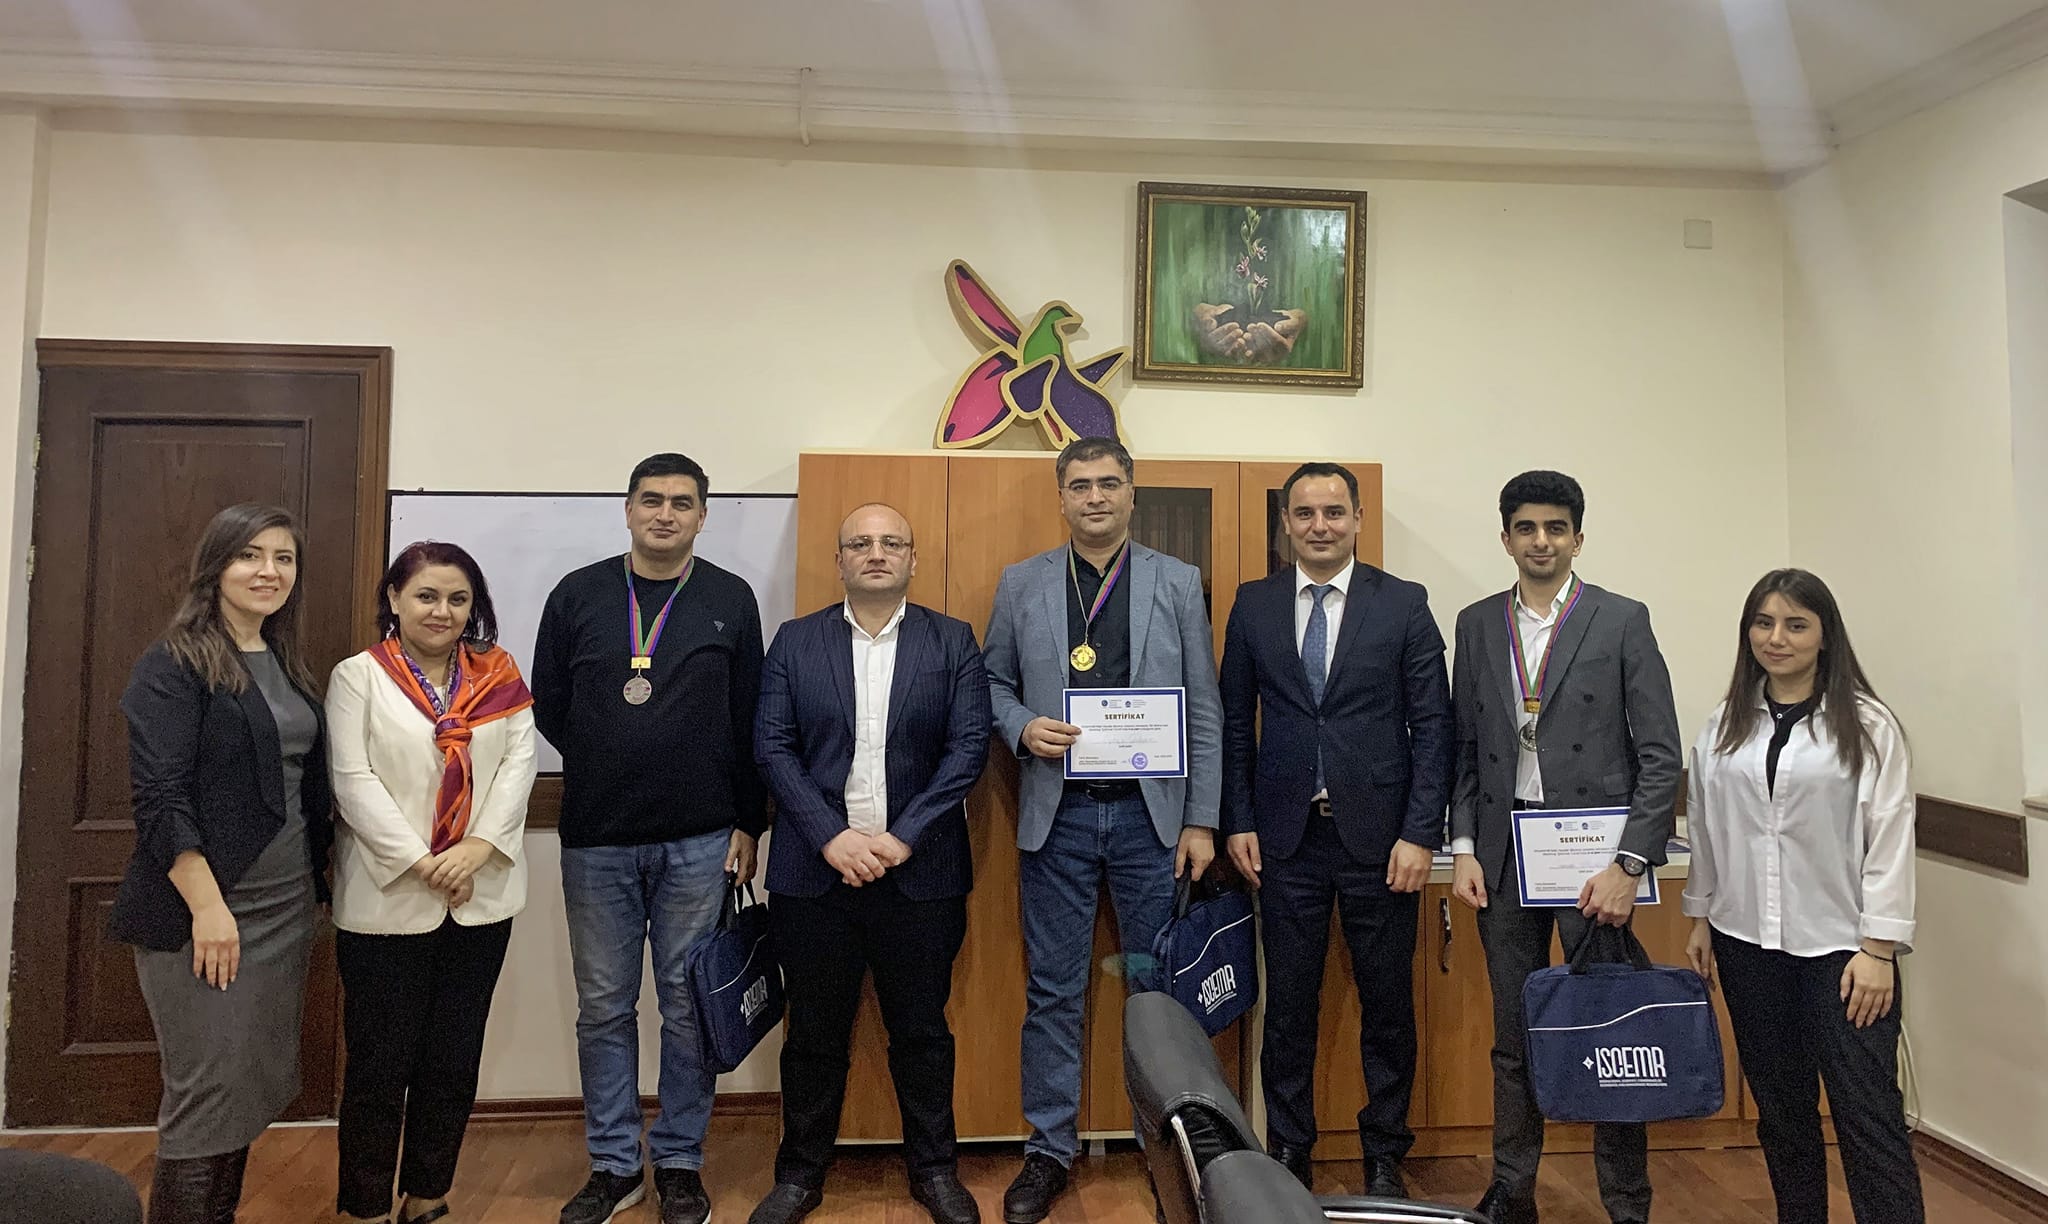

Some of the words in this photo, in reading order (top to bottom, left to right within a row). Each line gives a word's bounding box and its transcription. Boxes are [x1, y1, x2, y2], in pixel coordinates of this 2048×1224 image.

[1104, 712, 1145, 720] SERTİFİKAT
[1559, 835, 1606, 844] SERTİFİKAT
[1201, 964, 1236, 1008] ISCEMR
[1595, 1046, 1667, 1079] ISCEMR
